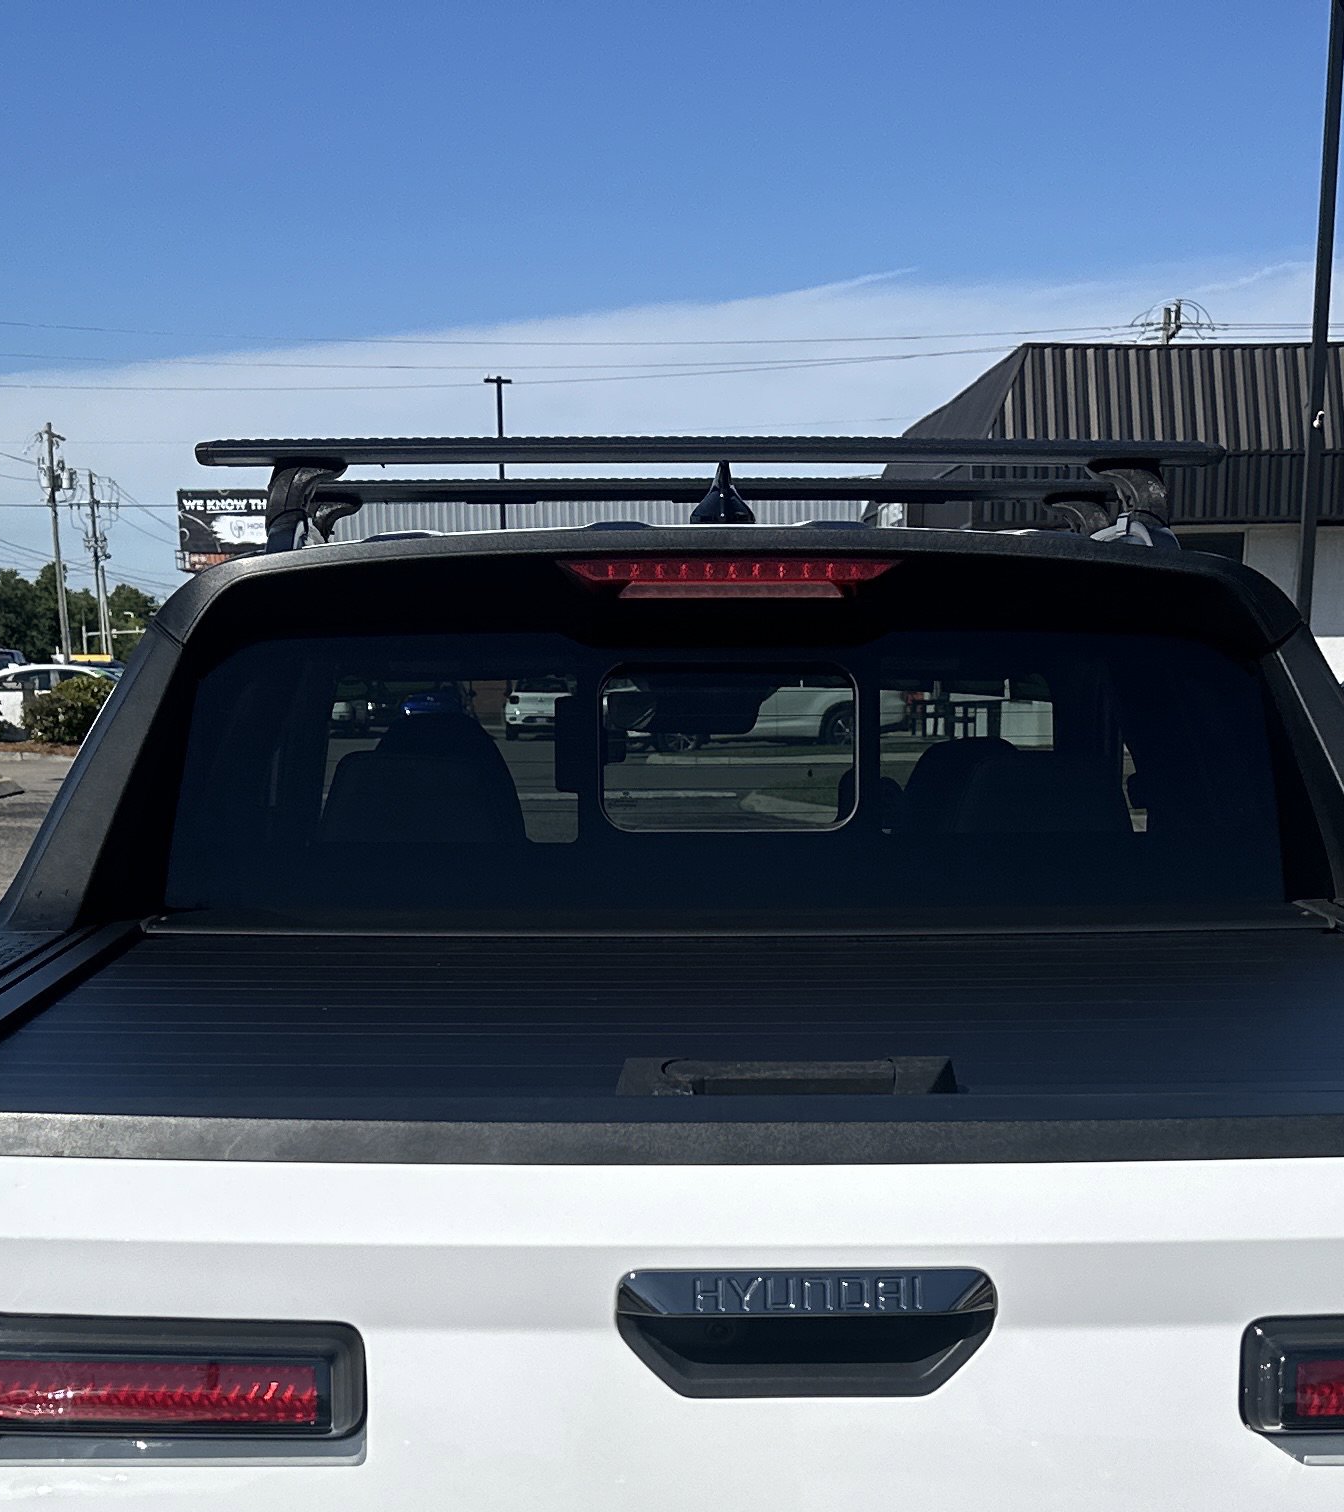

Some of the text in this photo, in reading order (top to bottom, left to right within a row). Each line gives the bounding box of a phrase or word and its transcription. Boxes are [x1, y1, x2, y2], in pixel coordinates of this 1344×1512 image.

[182, 499, 267, 511] WE KNOW TH
[694, 1276, 925, 1313] HYUNDAI
